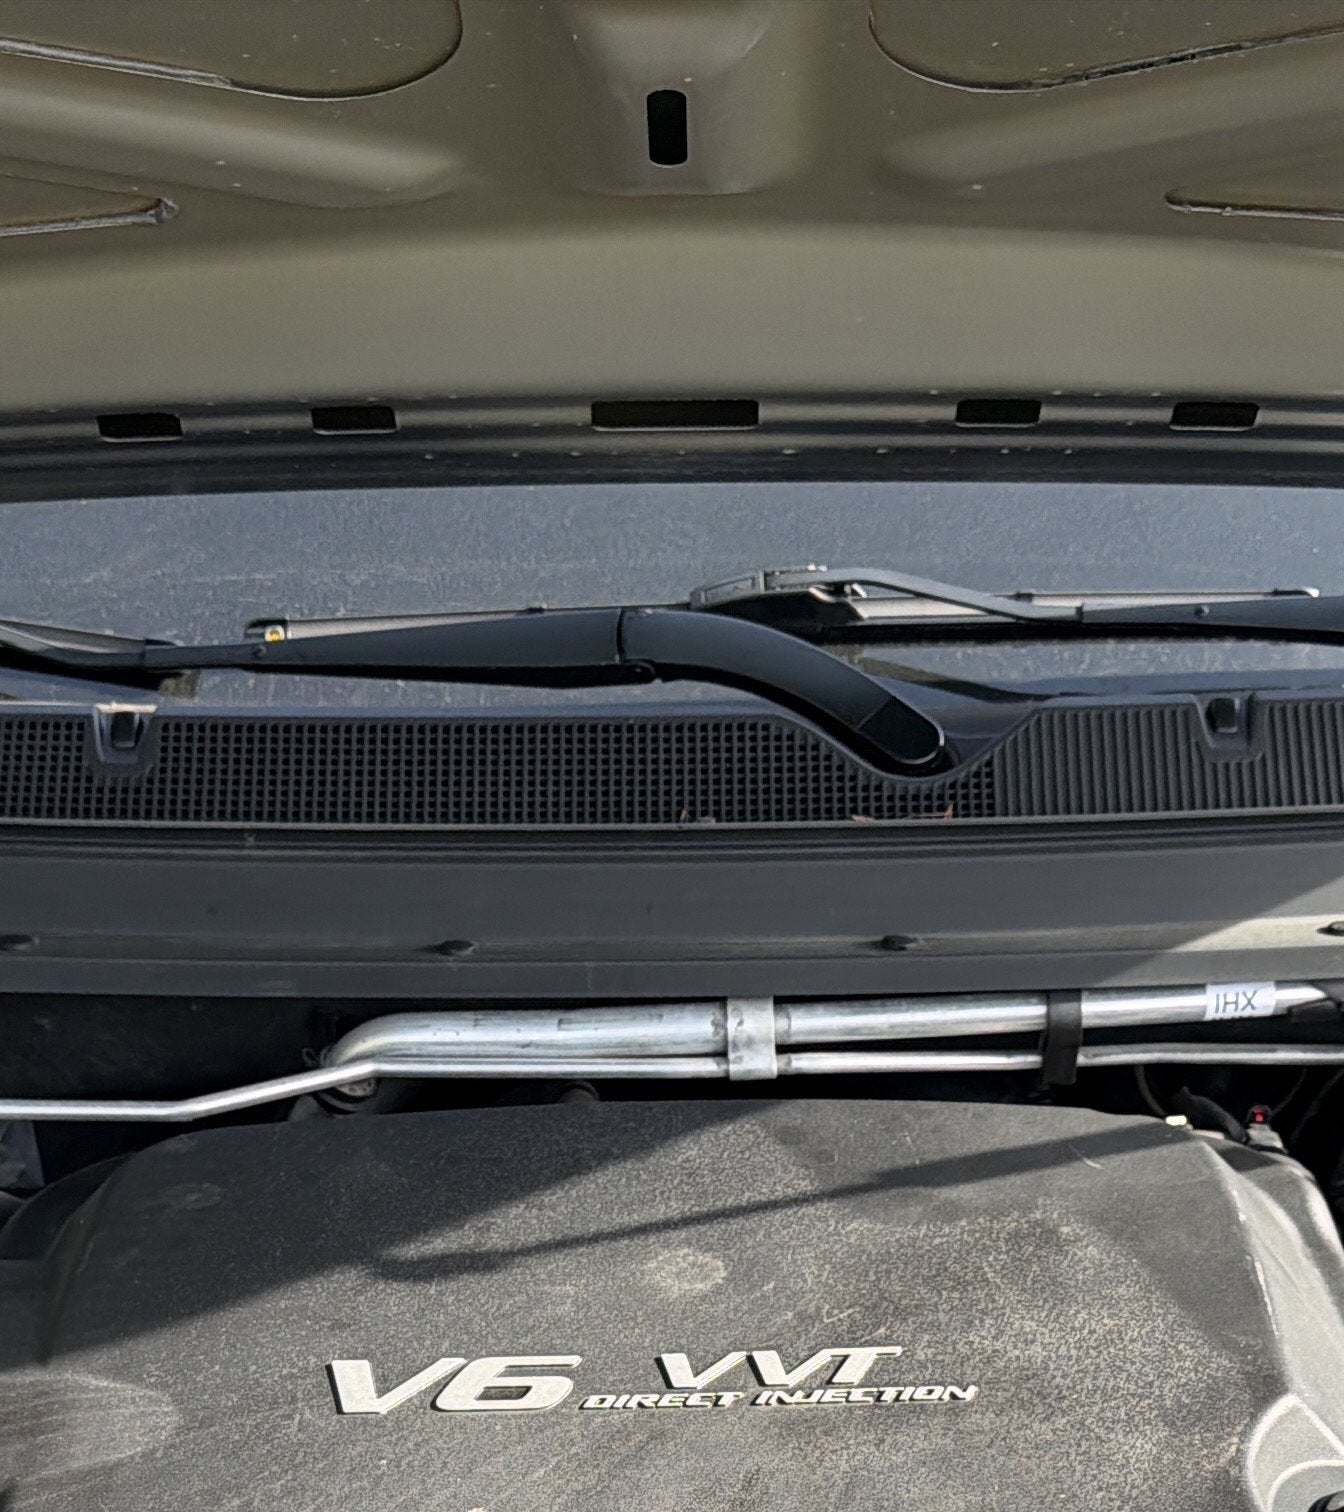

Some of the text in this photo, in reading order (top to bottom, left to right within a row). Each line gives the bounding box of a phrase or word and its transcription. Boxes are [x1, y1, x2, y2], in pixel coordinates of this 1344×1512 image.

[327, 1355, 583, 1414] V6
[658, 1345, 903, 1389] VVT
[581, 1385, 979, 1410] DIRECT INJECTION
